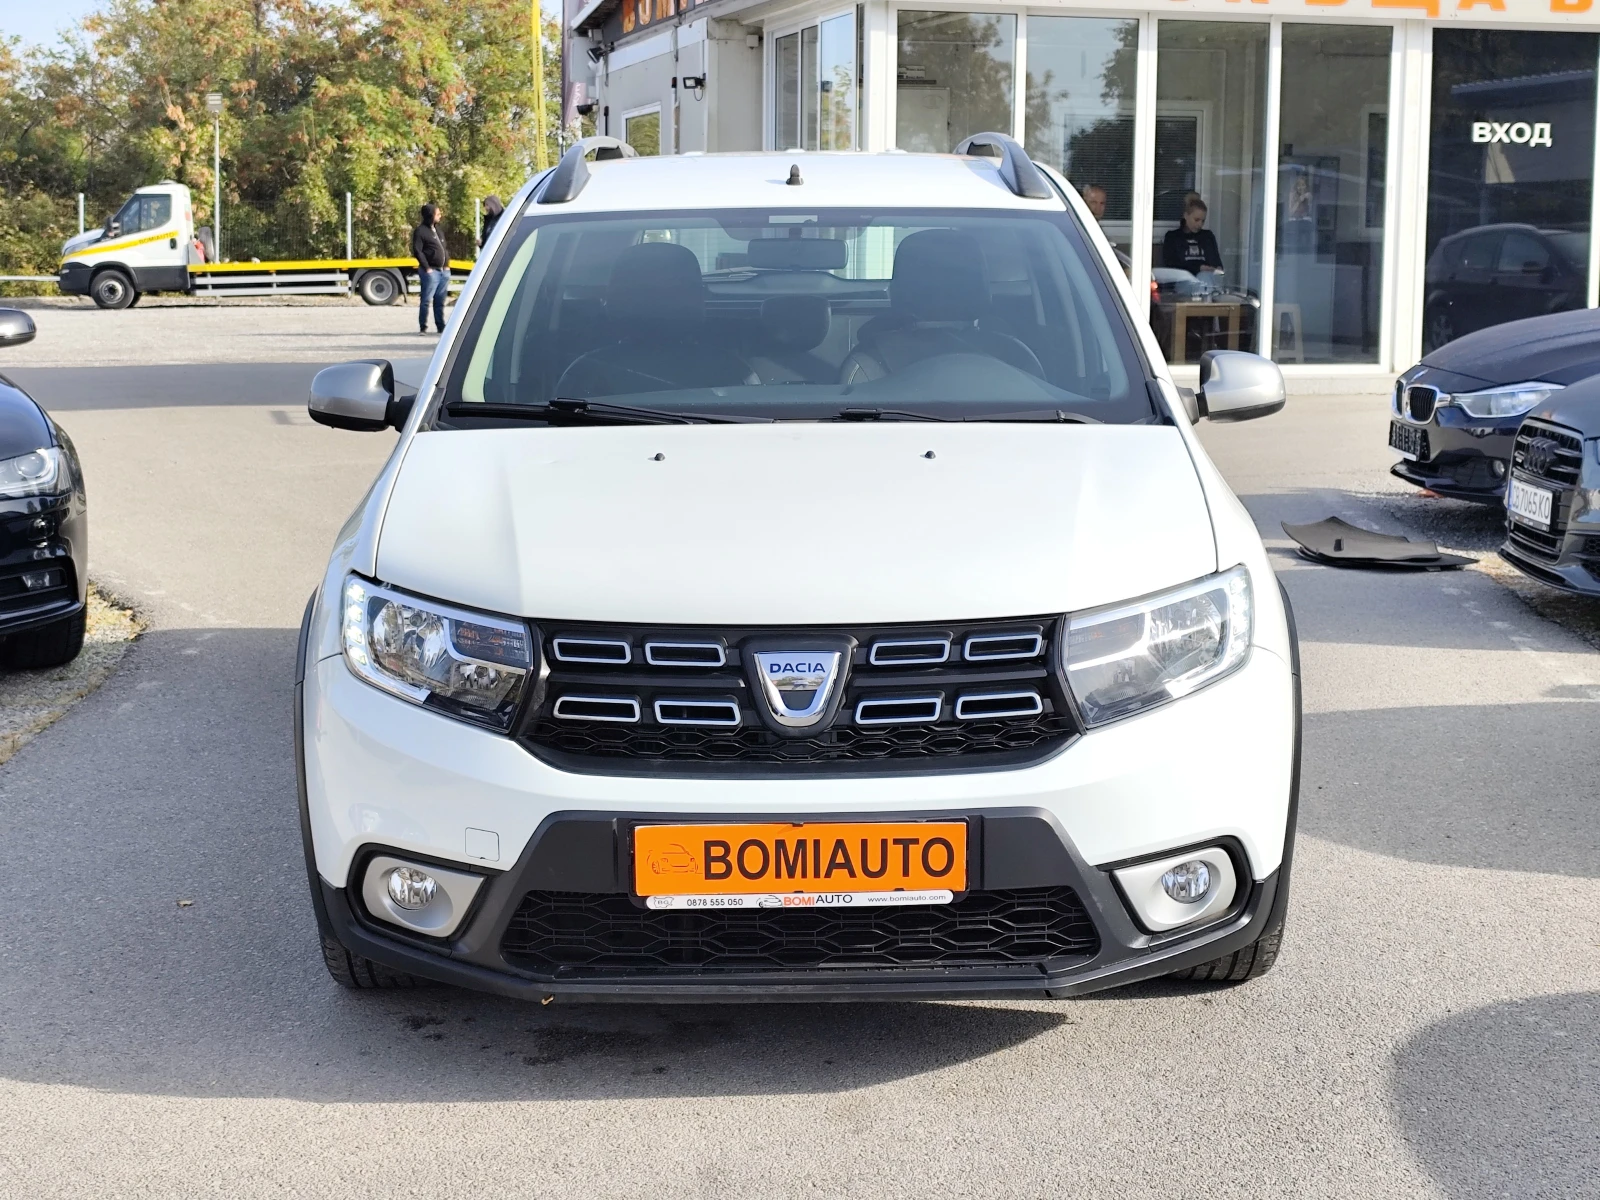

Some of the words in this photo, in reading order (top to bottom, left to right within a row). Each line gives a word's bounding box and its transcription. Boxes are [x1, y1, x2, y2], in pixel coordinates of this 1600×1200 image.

[1472, 121, 1553, 148] ВХОД
[138, 231, 175, 245] BOMIAUTO
[769, 662, 826, 674] DACIA
[703, 837, 955, 881] BOMIAUTO
[686, 898, 708, 907] 0878
[710, 898, 725, 906] 555
[727, 897, 744, 906] 050
[867, 893, 947, 903] www.bomiauto.com
